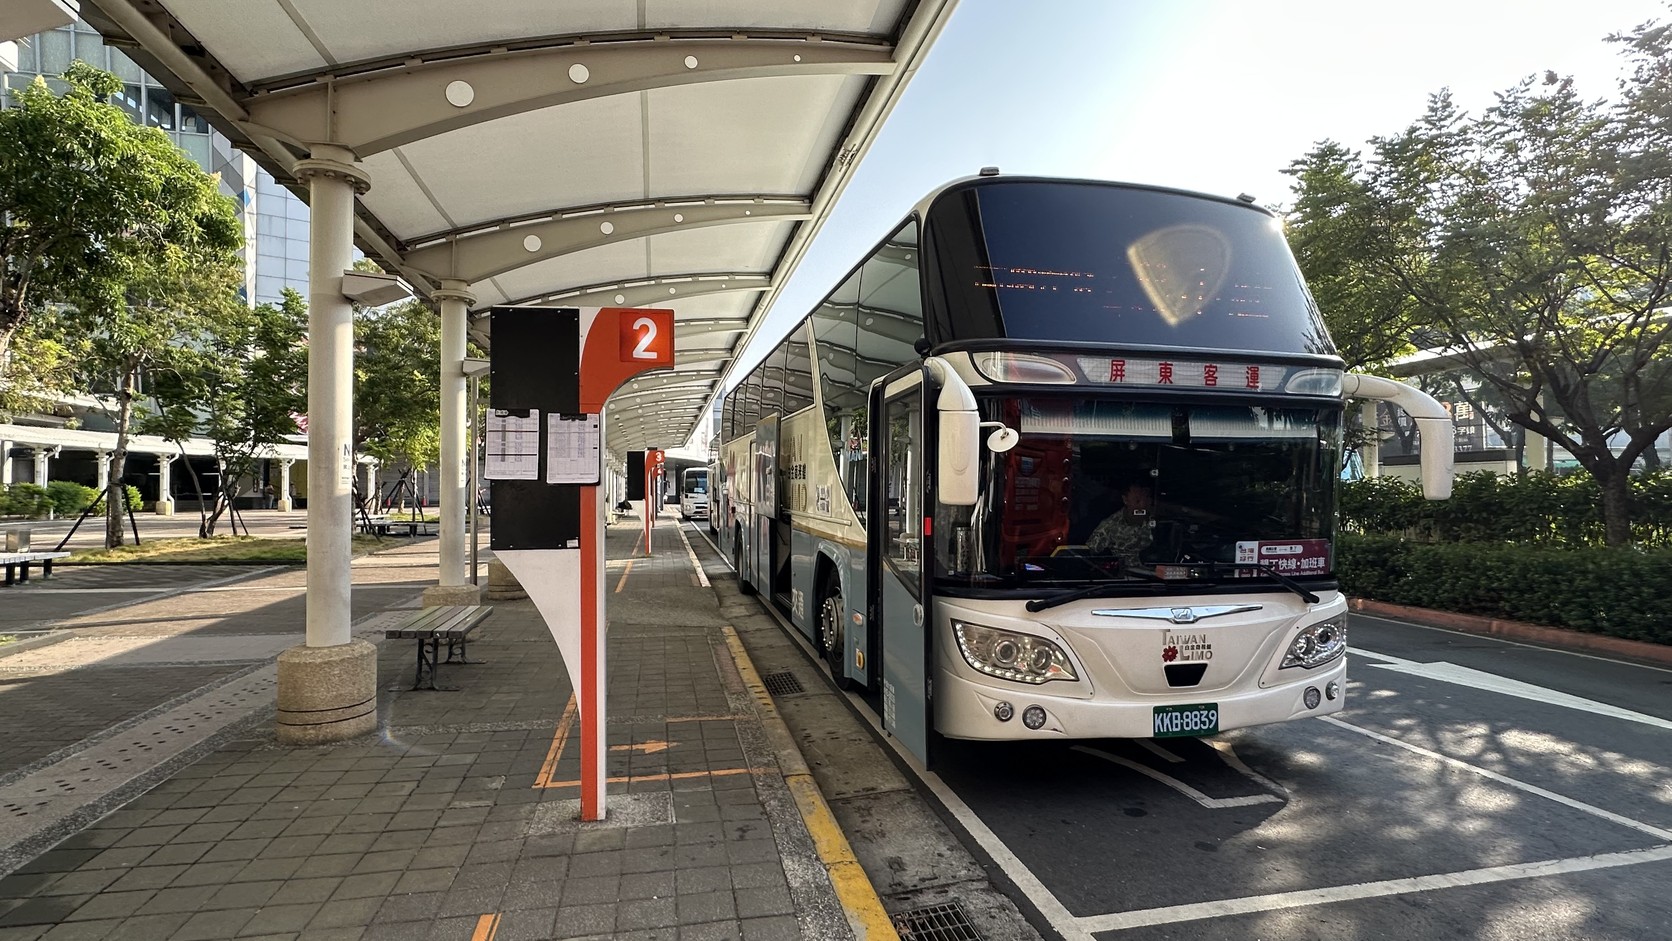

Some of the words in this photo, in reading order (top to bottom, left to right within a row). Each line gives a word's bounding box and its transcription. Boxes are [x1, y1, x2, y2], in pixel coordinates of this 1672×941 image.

[632, 317, 658, 360] 2
[1109, 359, 1260, 389] 屏東客運
[655, 451, 662, 462] 3
[1160, 629, 1206, 646] TAIWAN
[1179, 645, 1213, 661] LIMO
[1154, 709, 1218, 733] KKB-8839
